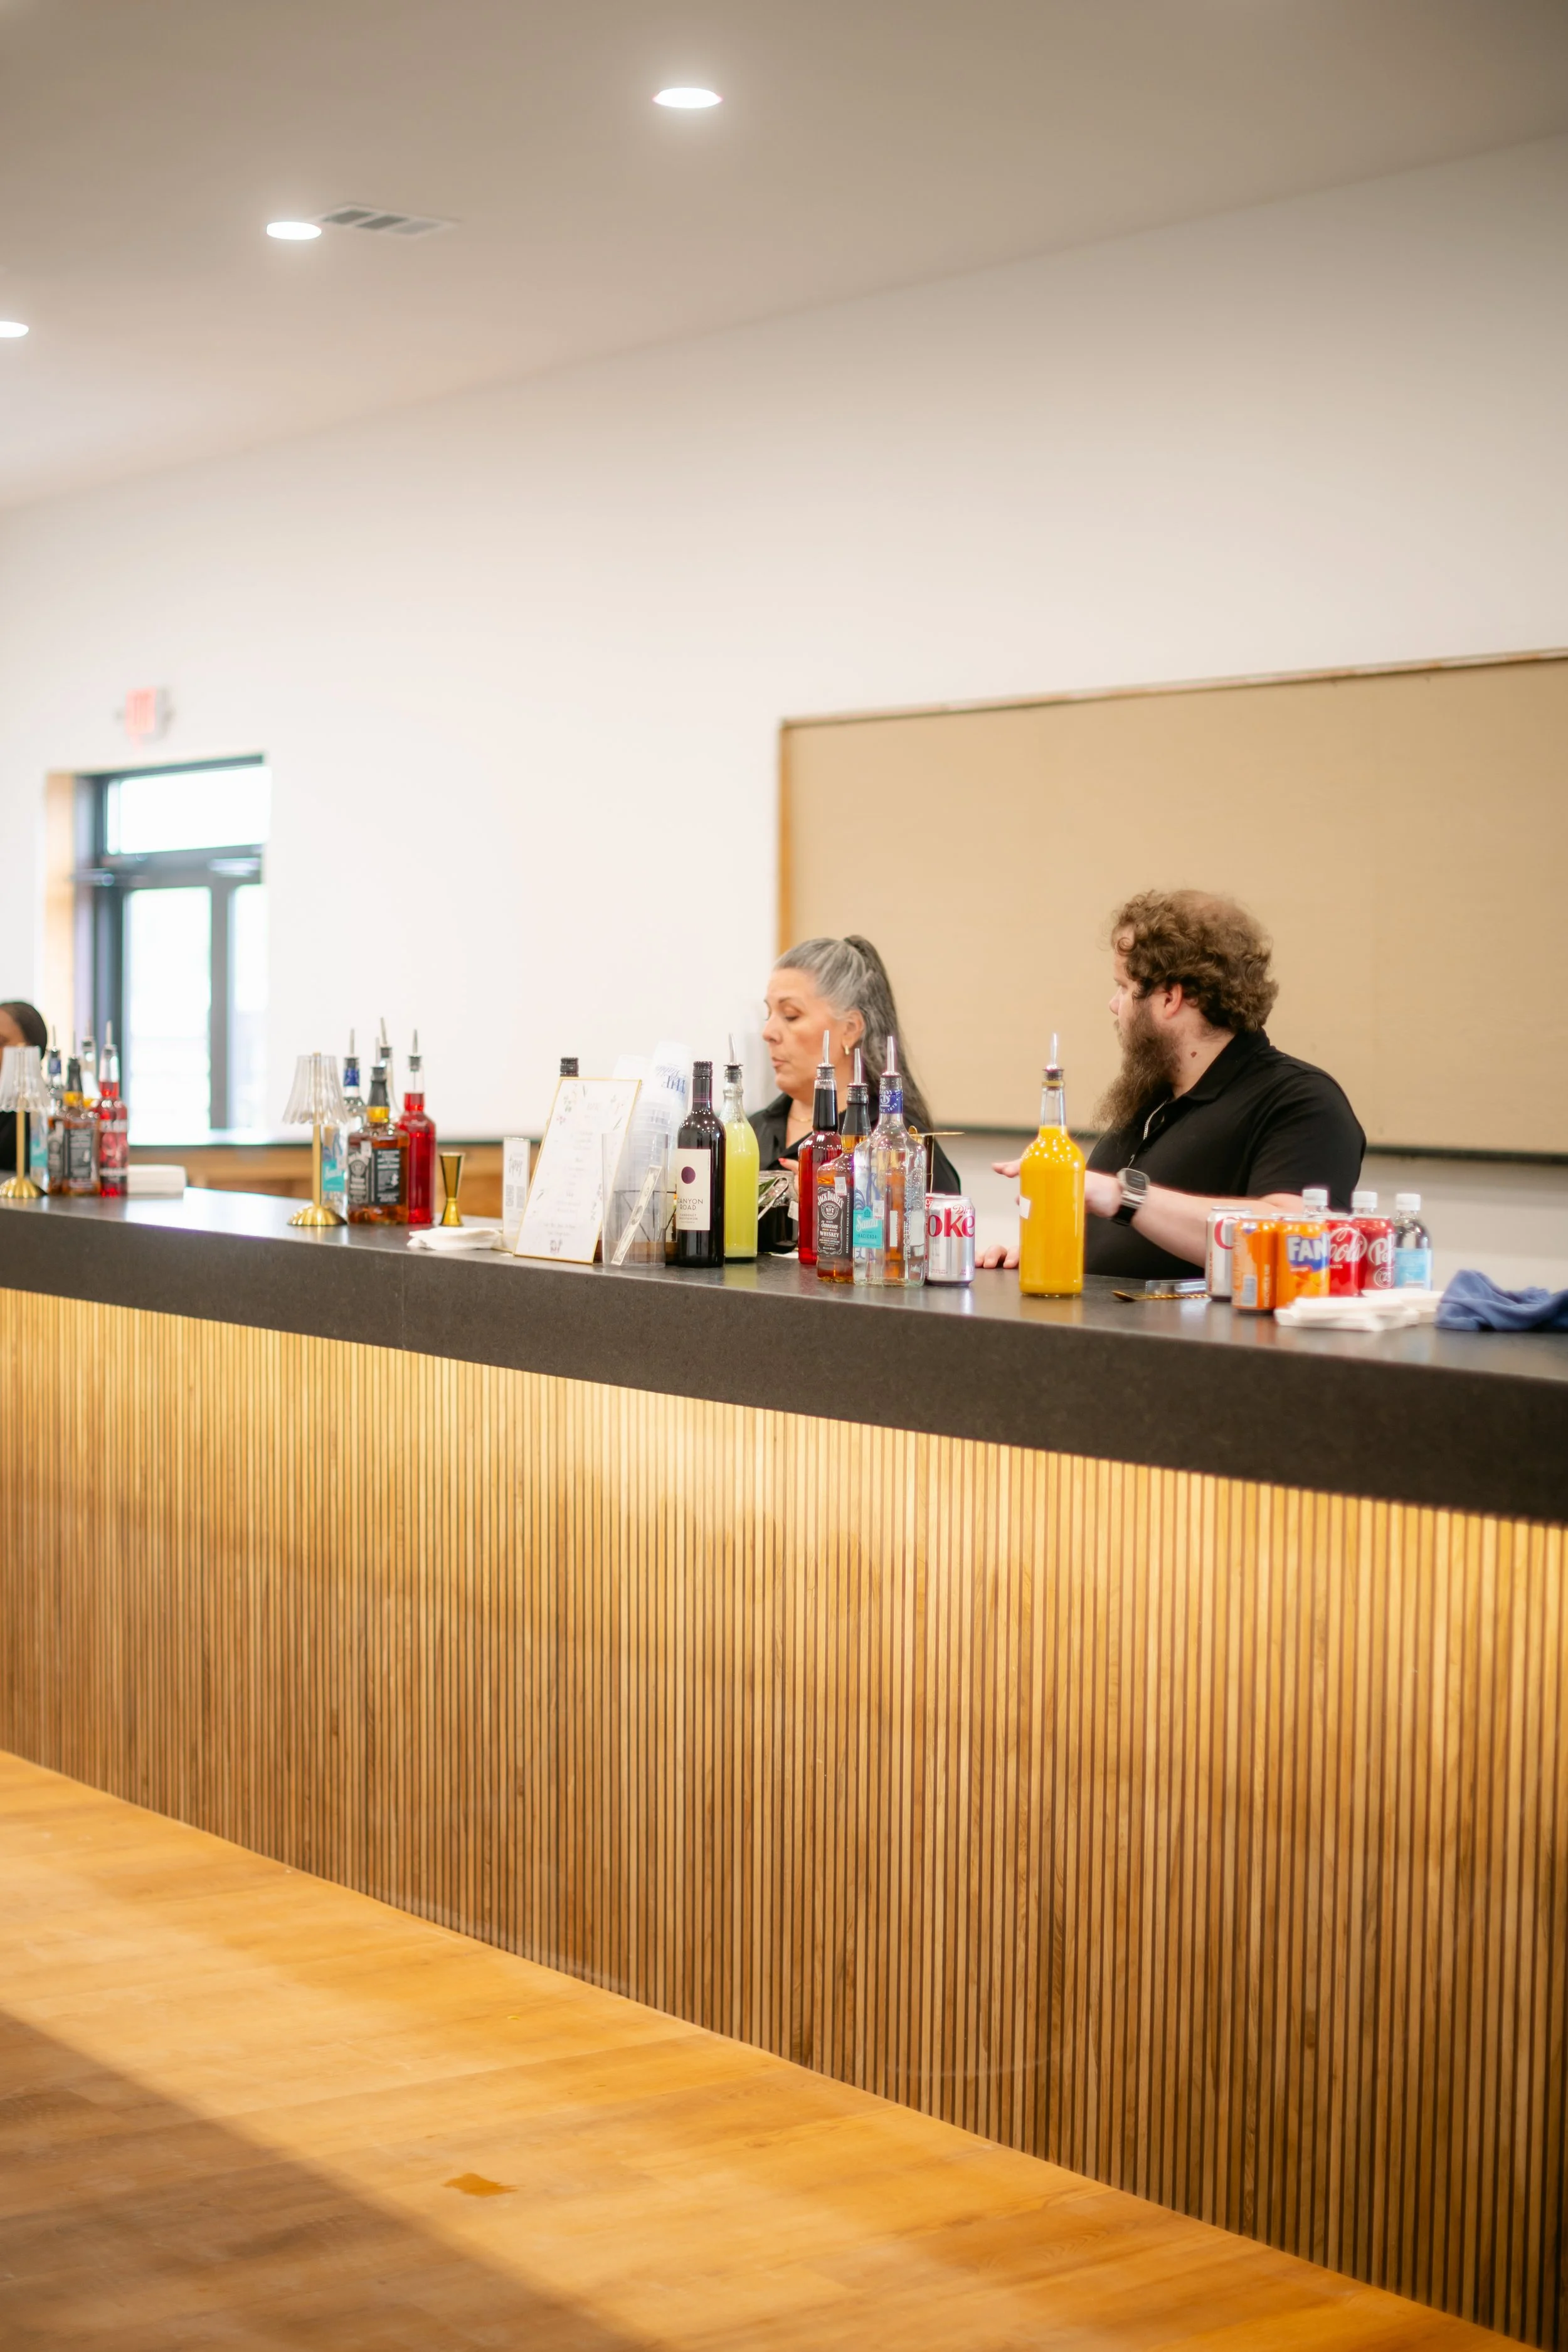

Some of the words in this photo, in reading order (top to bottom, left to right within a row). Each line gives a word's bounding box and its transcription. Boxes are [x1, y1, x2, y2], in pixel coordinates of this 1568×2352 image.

[817, 1192, 828, 1206] JACK
[827, 1190, 844, 1210] DANIEL'S
[953, 1204, 972, 1215] Diet
[819, 1230, 840, 1238] WHISKEY
